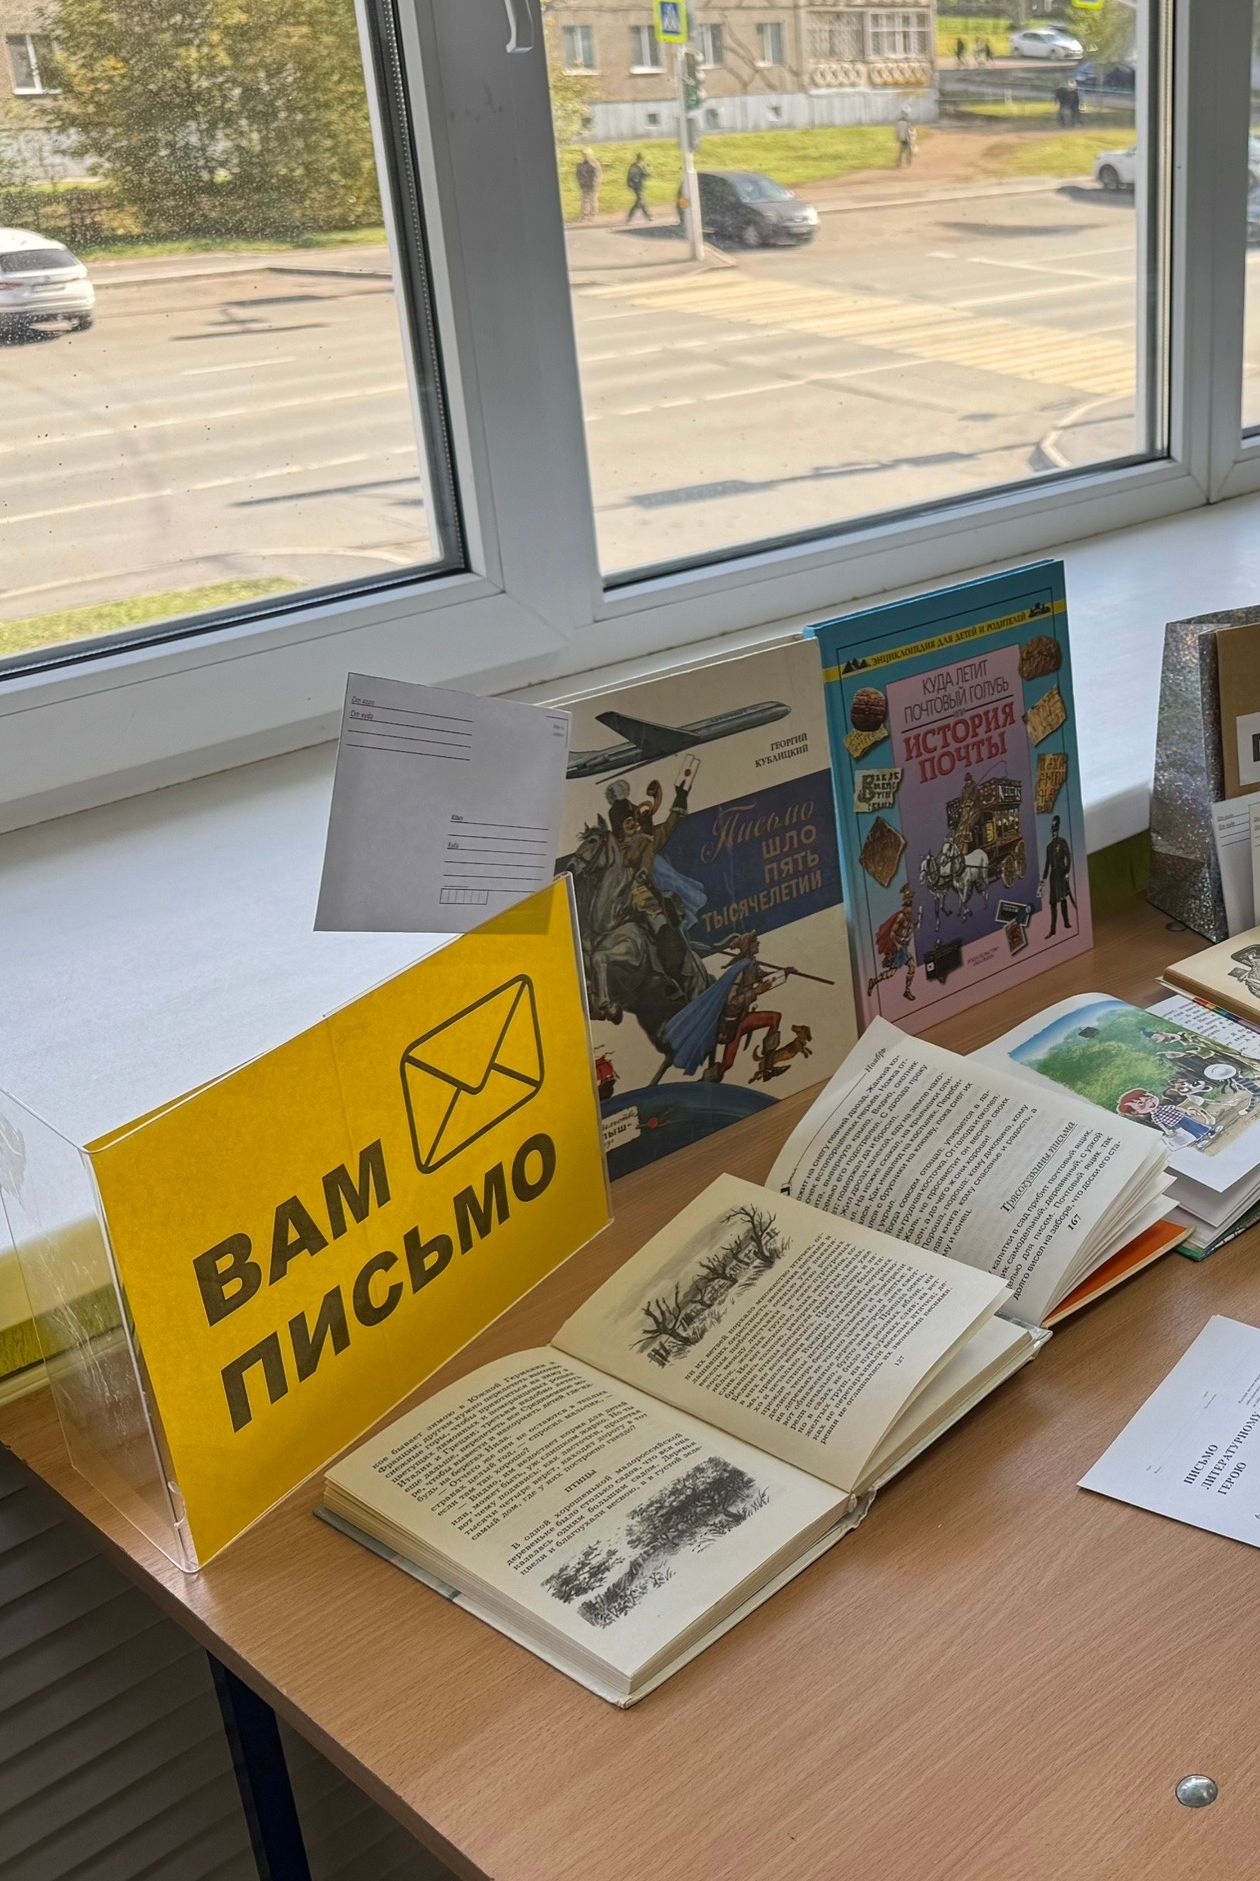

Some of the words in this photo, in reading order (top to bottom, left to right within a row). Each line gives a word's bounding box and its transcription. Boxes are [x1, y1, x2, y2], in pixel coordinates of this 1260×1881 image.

[872, 641, 936, 665] ЭНЦИКЛОПЕДИЯ
[937, 635, 953, 648] ДЛЯ
[955, 627, 976, 643] ДЕТЕЙ
[978, 625, 985, 635] И
[986, 612, 1027, 632] РОДИТЕЛЕЙ
[922, 672, 953, 695] КУДА
[955, 660, 988, 685] ЛЕТИТ
[904, 687, 967, 724] ПОЧТОВЫЙ
[969, 677, 1009, 700] ГОЛУБЬ
[770, 733, 808, 751] ГЕОРГИЙ
[904, 702, 1016, 761] ИСТОРИЯ
[755, 744, 809, 768] КУБЛИЦКИЙ
[919, 731, 1007, 784] ПОЧТЫ
[701, 801, 814, 864] Письмо
[761, 825, 816, 860] ШЛО
[765, 850, 819, 884] ПЯТЬ
[871, 1089, 895, 1114] Видно,
[893, 1060, 919, 1088] охотник
[877, 1068, 900, 1091] Ножка
[935, 1108, 951, 1125] пока
[1047, 1119, 1076, 1153] письма
[1084, 1130, 1103, 1153] узкой
[812, 1144, 829, 1167] снегу
[836, 1167, 848, 1182] его
[850, 1168, 870, 1196] дрозд
[867, 1185, 881, 1202] Как
[991, 1234, 1015, 1270] калитки
[1016, 1211, 1030, 1228] сад
[1026, 1183, 1049, 1213] прибит
[1047, 1149, 1076, 1185] почтовый
[1021, 1242, 1034, 1260] для
[1053, 1170, 1084, 1209] Почтовый
[1083, 1150, 1101, 1170] ящик
[1100, 1135, 1113, 1148] так
[192, 1138, 391, 1327] ВАМ
[1012, 1271, 1030, 1300] долго
[1026, 1244, 1045, 1272] висел
[1071, 1189, 1084, 1204] что
[1081, 1167, 1101, 1190] доски
[1097, 1154, 1111, 1169] его
[1067, 1213, 1082, 1231] 167
[221, 1132, 557, 1434] ПИСЬМО
[563, 1468, 597, 1492] ПТИЦЫ
[1184, 1444, 1219, 1485] ПИСЬМО
[1218, 1461, 1248, 1496] ГЕРОЮ
[522, 1519, 551, 1541] одной
[554, 1508, 579, 1527] было
